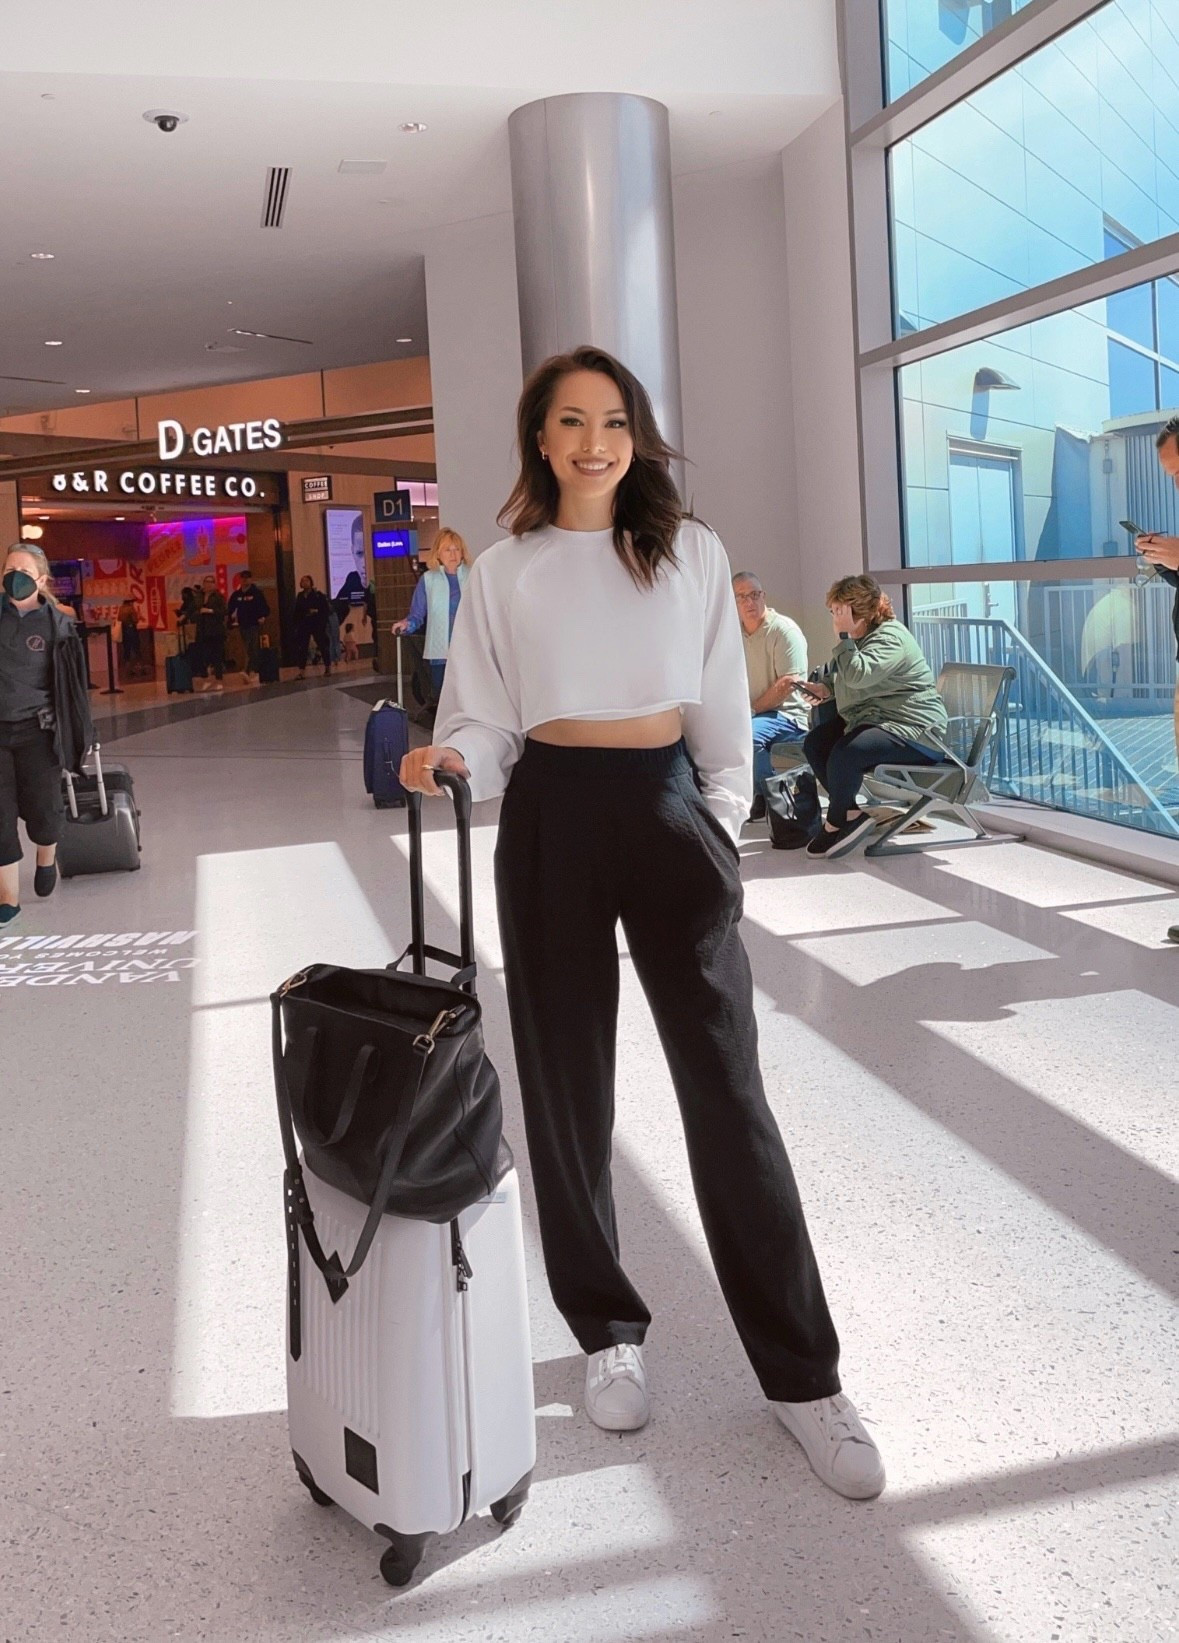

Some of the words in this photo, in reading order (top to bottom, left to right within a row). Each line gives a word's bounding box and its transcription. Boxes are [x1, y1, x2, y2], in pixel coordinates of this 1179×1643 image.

[158, 419, 184, 460] D
[192, 418, 281, 456] GATES
[120, 471, 216, 496] COFFEE
[224, 476, 265, 498] CO.
[304, 480, 328, 489] COFFEE
[382, 498, 403, 517] D1
[35, 949, 168, 959] WELCOMES
